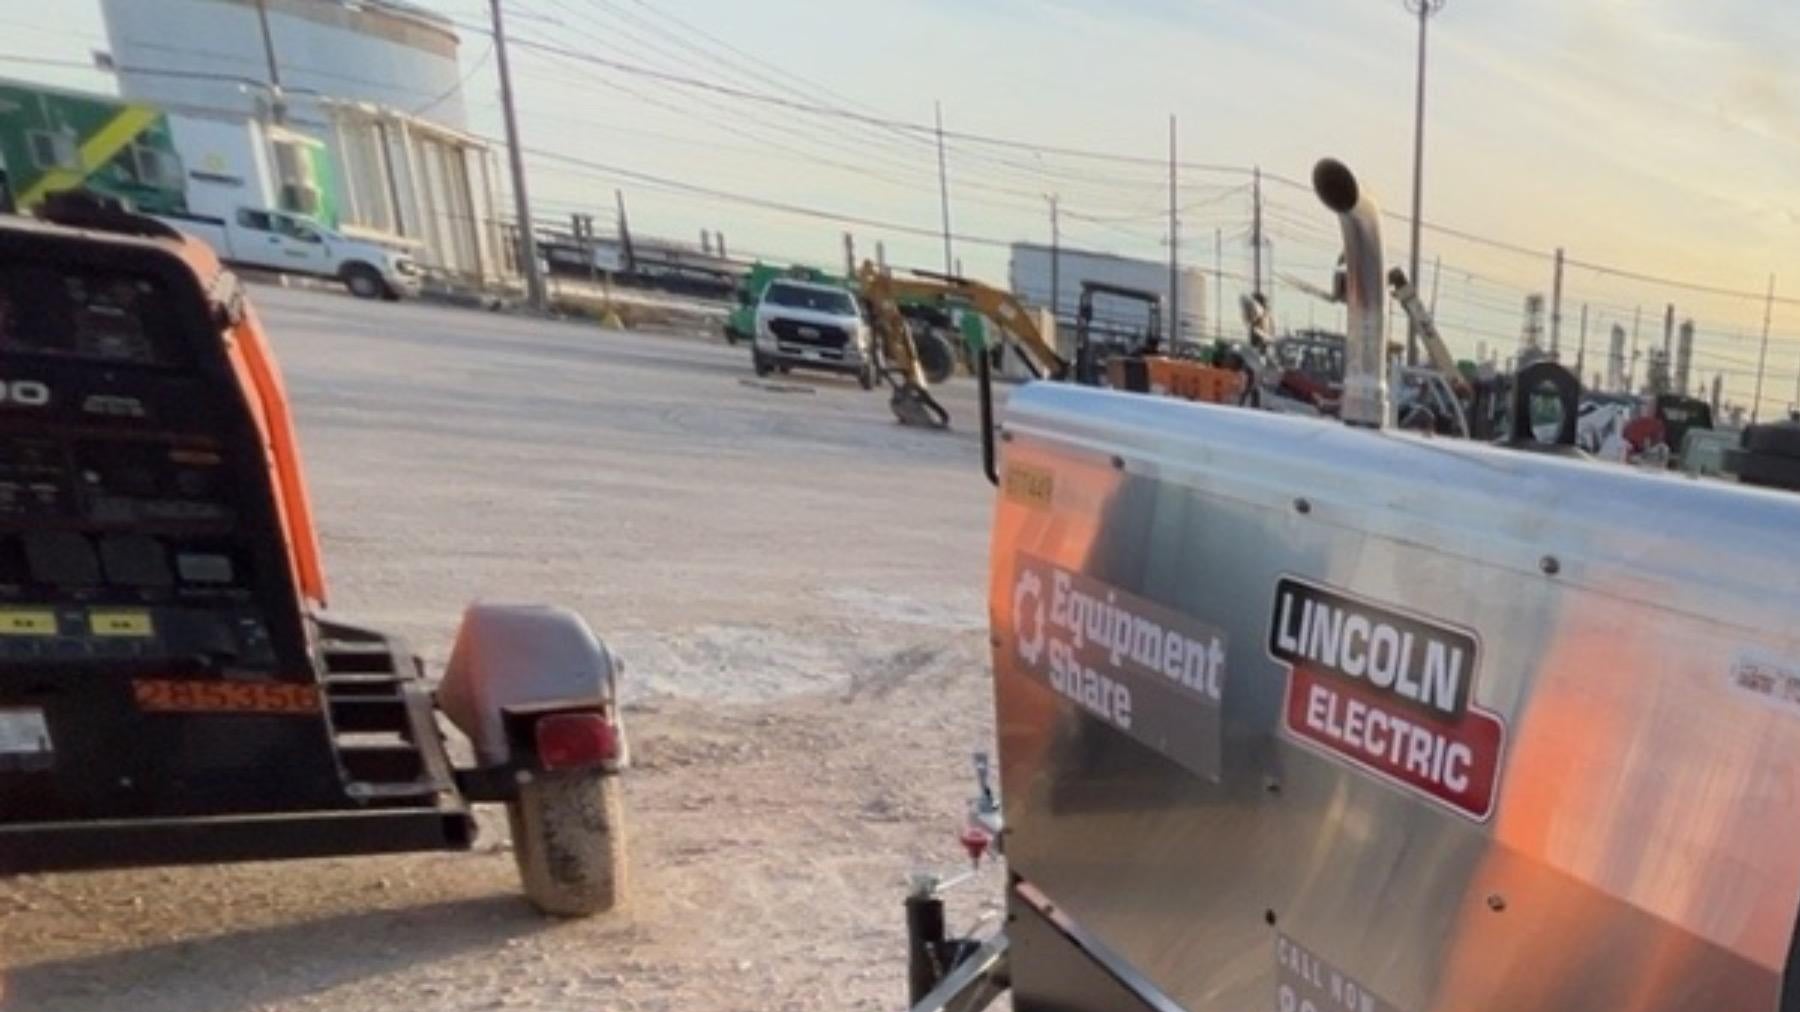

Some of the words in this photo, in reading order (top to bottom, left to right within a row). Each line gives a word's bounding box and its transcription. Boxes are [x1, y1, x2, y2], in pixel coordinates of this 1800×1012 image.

[1048, 637, 1133, 730] Share
[1050, 568, 1225, 700] Equipment
[1277, 592, 1464, 713] LINCOLN
[1305, 683, 1473, 793] ELECTRIC
[1277, 937, 1324, 988] CALL
